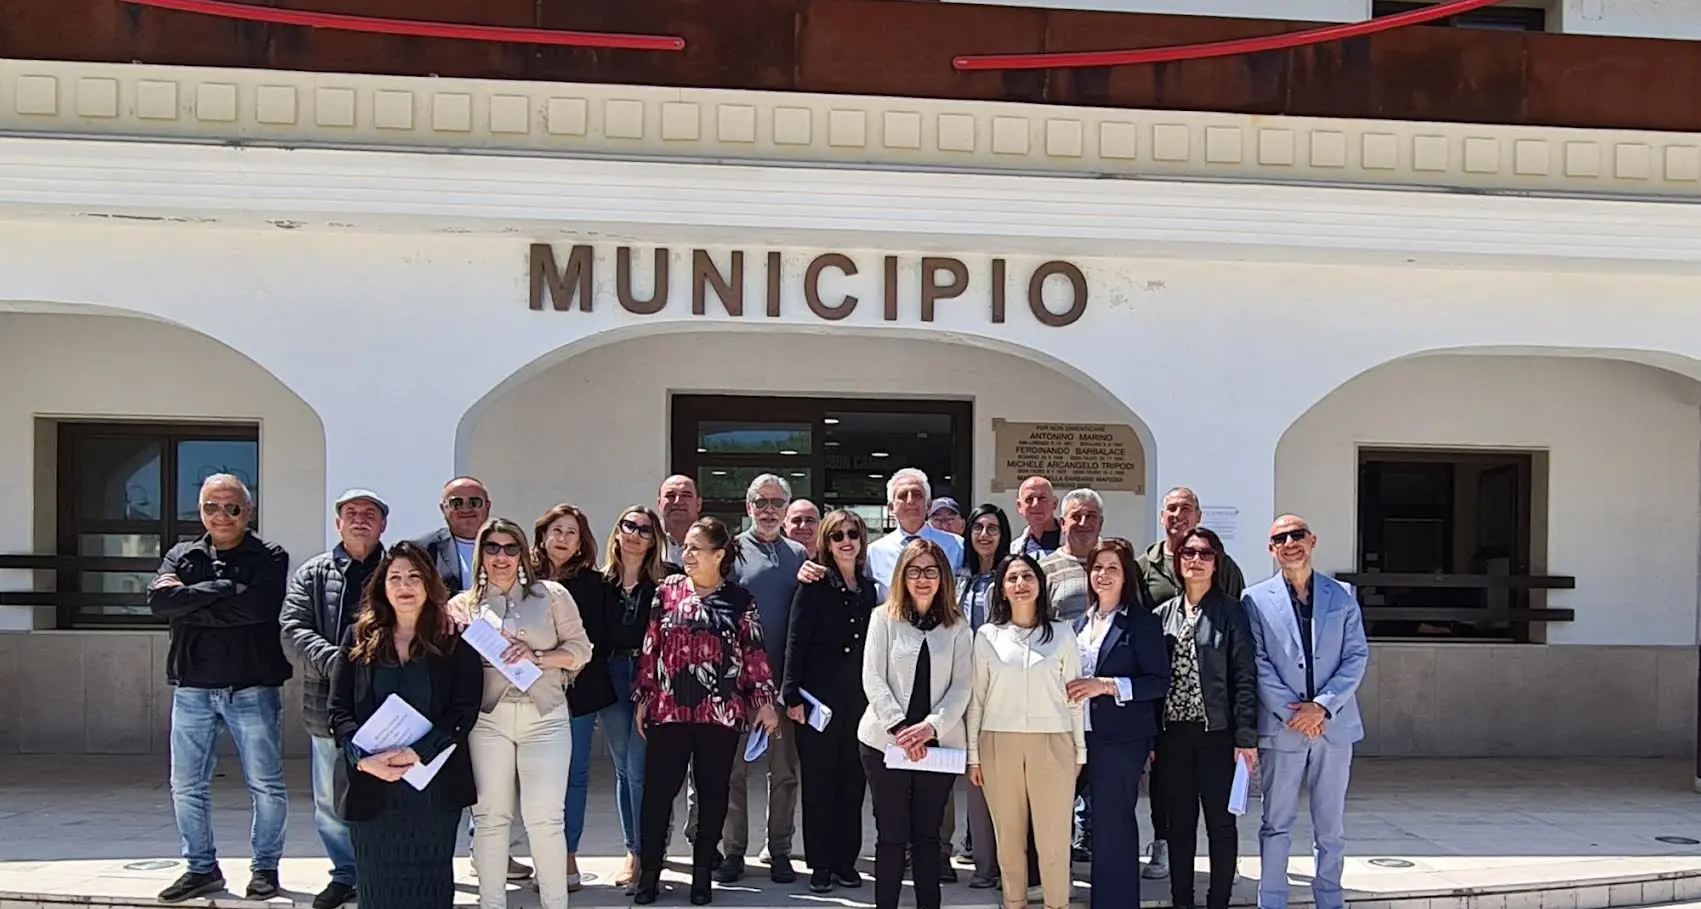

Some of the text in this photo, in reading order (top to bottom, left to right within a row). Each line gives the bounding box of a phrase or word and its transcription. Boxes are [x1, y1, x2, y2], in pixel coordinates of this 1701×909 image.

[529, 243, 1088, 326] MUNICIPIO
[1030, 433, 1113, 442] ANTONINO MARINO
[1016, 446, 1126, 456] FERDINANDO BARBALACE
[1007, 460, 1134, 470] MICHELE ARCANGELO TRIPODI
